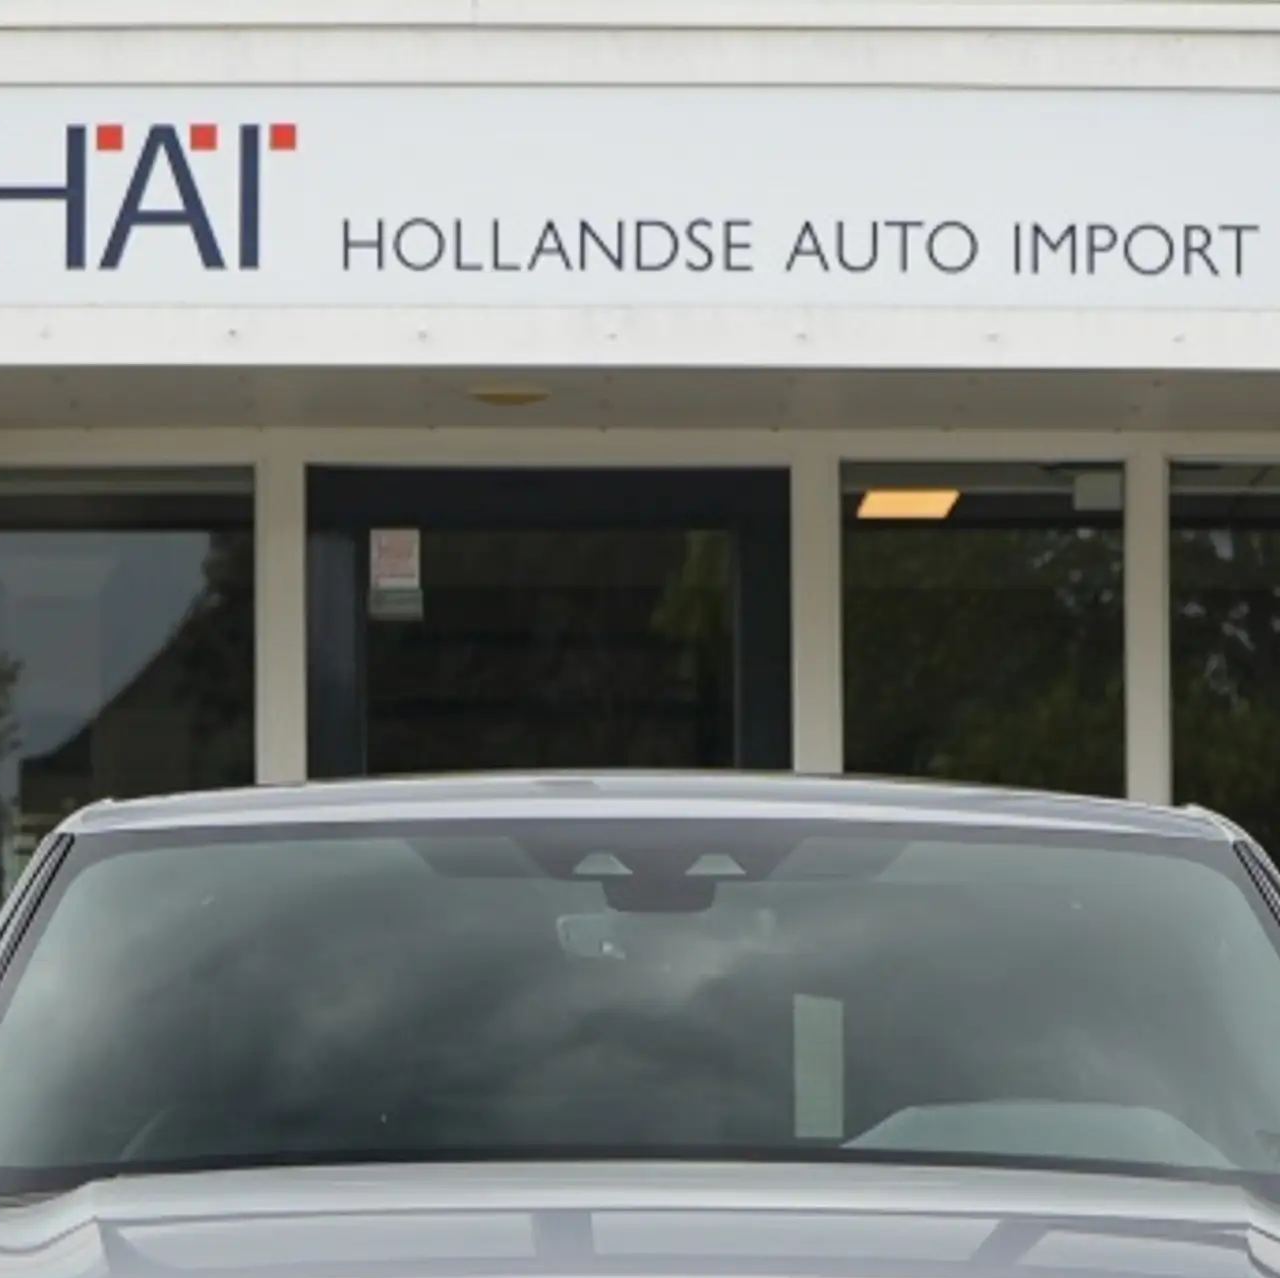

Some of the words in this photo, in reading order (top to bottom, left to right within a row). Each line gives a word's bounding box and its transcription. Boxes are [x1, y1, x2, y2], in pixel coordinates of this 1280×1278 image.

[341, 216, 754, 272] HOLLANDSE
[785, 219, 980, 275] AUTO
[1012, 222, 1260, 277] IMPORT
